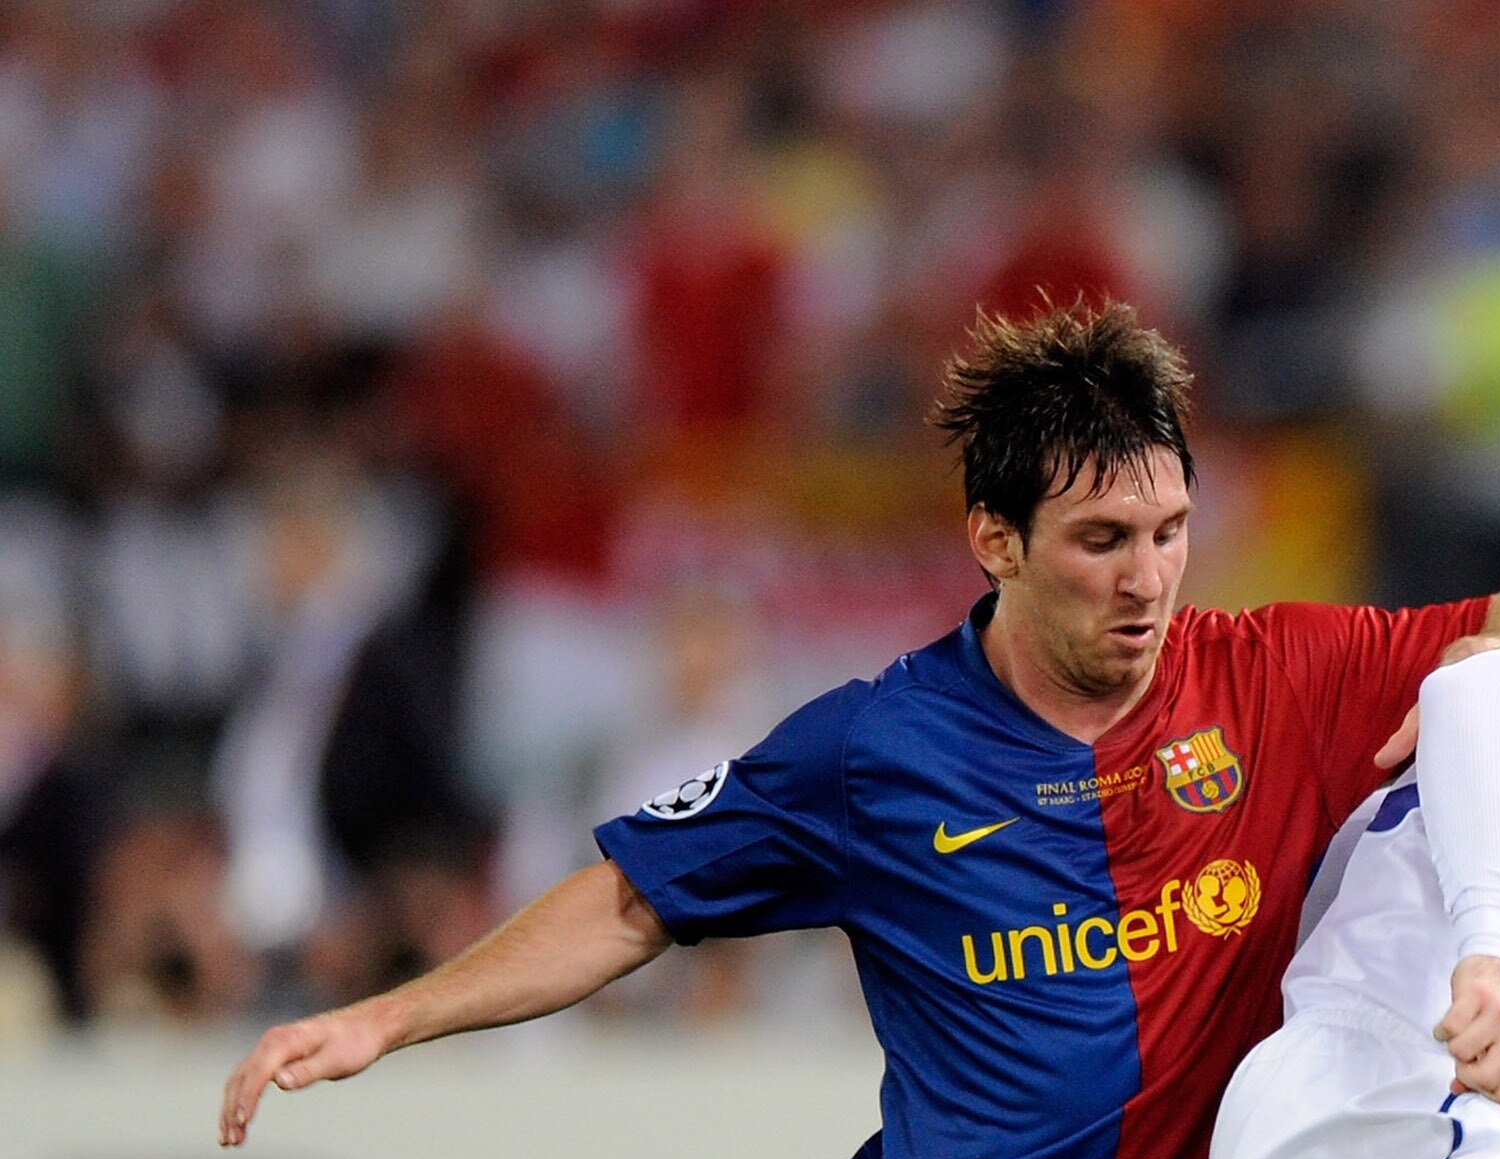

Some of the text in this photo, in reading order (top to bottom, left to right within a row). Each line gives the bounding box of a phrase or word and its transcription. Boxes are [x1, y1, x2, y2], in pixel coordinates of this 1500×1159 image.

[1036, 781, 1077, 796] FINAL
[1079, 771, 1122, 792] ROMA
[961, 878, 1182, 986] unicef
